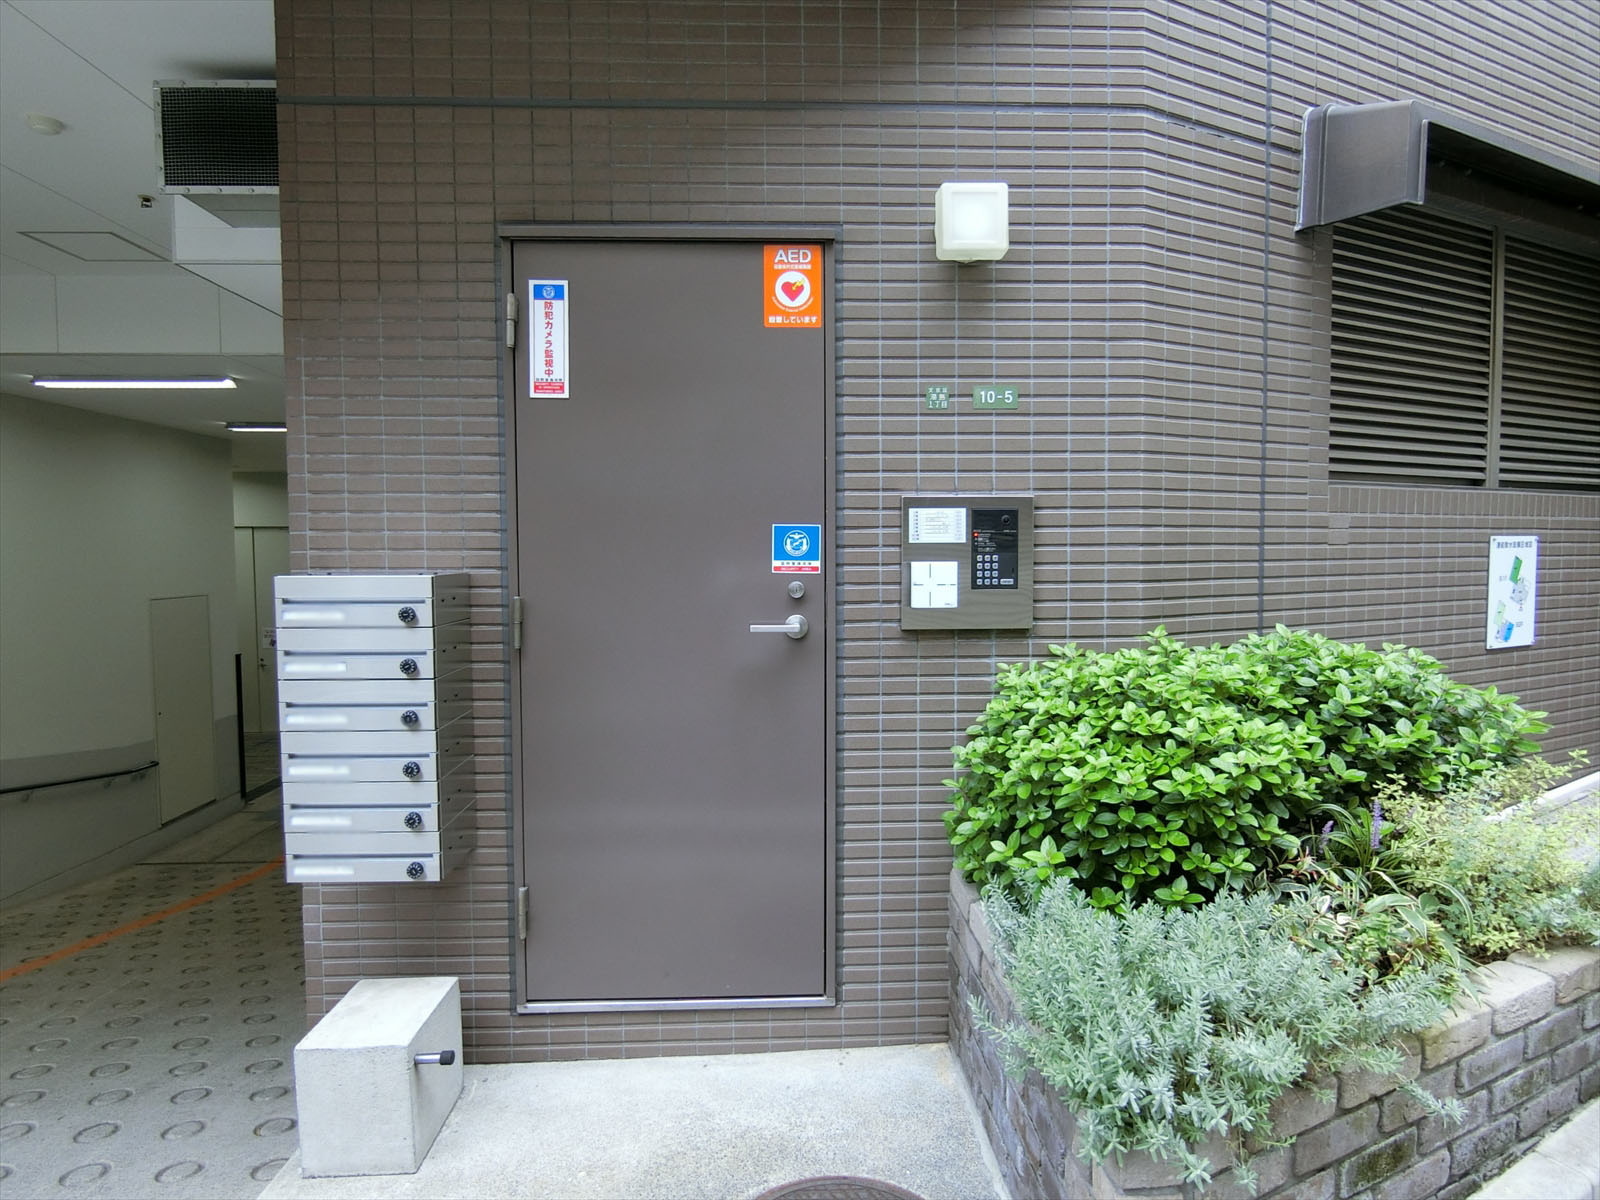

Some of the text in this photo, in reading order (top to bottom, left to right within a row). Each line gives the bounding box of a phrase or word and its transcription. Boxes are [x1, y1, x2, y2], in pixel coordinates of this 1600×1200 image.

[774, 249, 812, 263] AED
[544, 301, 554, 378] 防犯カメラ監視中
[928, 400, 948, 408] 1丁目
[980, 390, 1013, 404] 10-5
